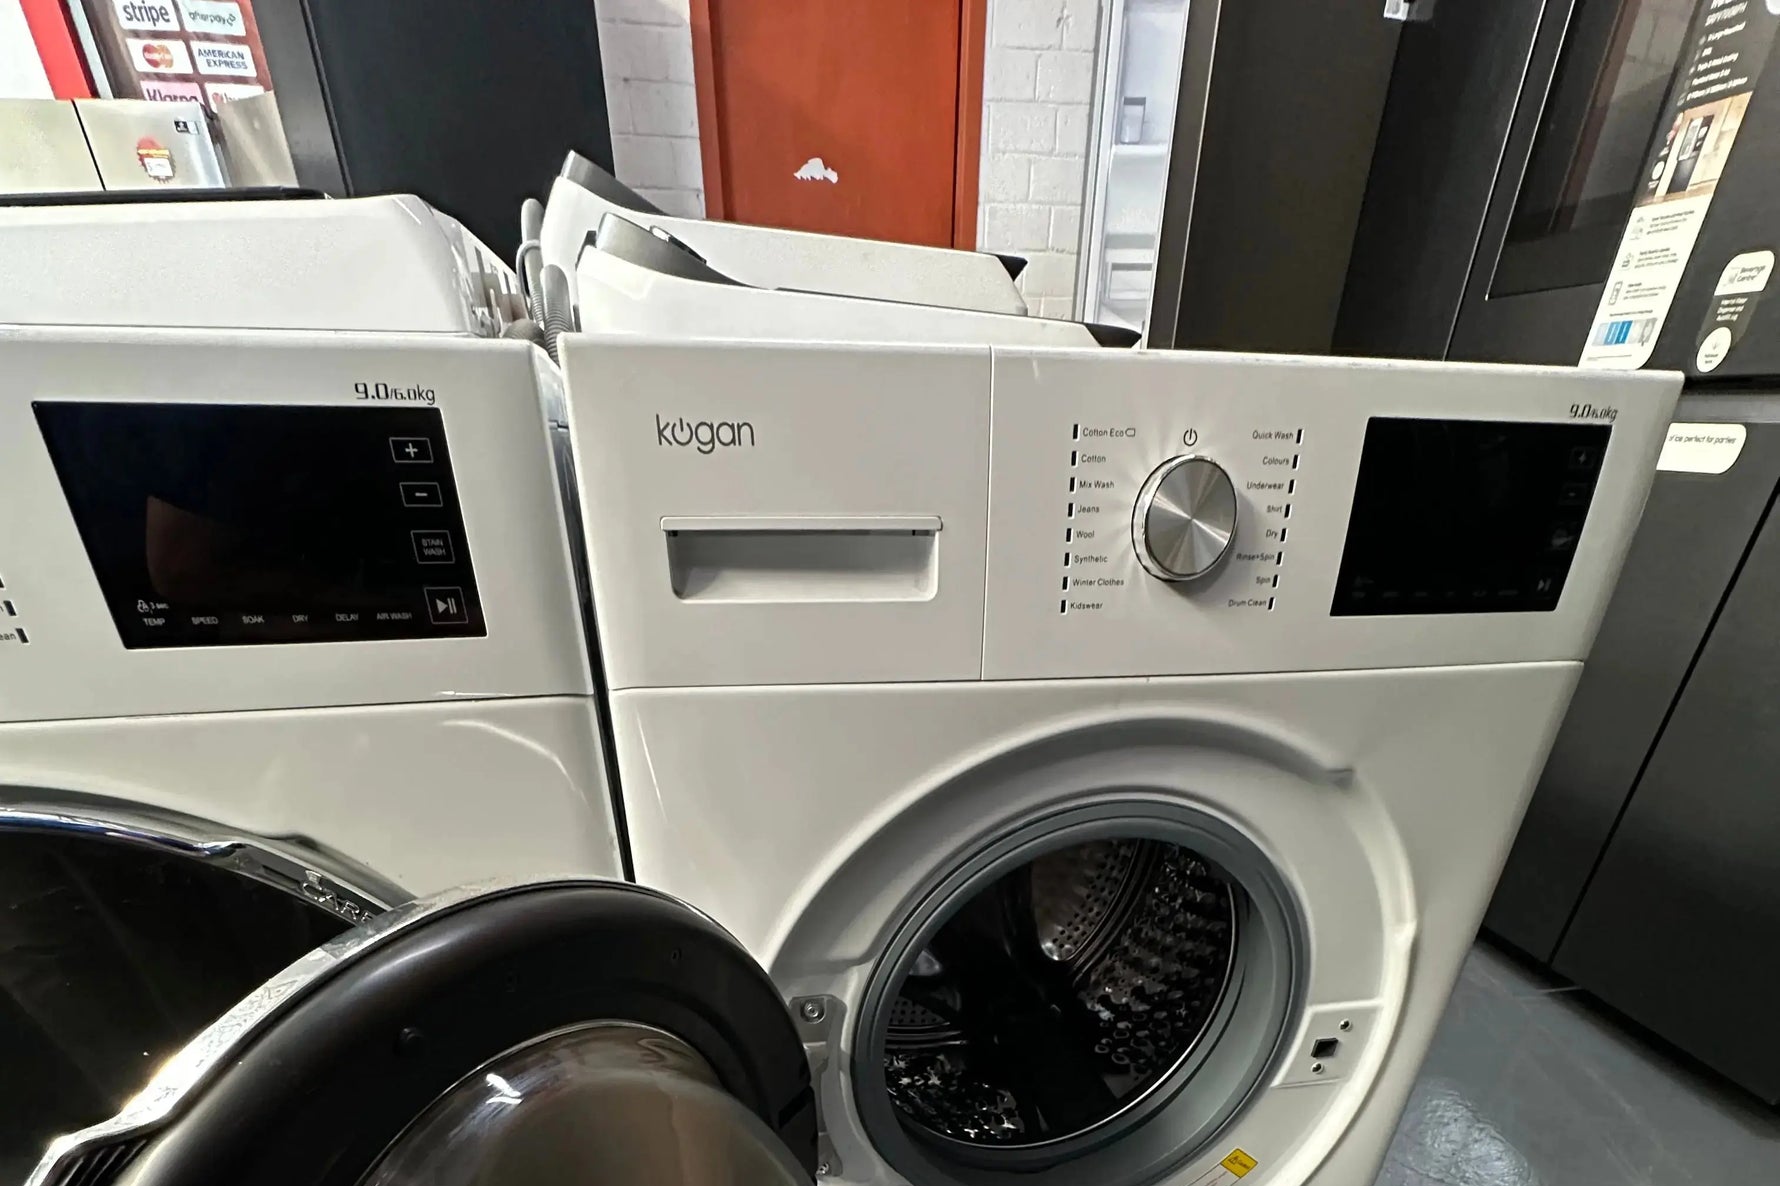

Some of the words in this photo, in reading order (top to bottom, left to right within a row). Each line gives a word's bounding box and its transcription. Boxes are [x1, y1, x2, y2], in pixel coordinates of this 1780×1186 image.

[122, 1, 171, 27] stripe
[198, 48, 245, 60] AMERICAN
[206, 59, 248, 70] EXPRESS
[656, 413, 755, 455] kogan
[1082, 428, 1108, 437] Cotton
[1109, 428, 1124, 437] Eco
[1252, 431, 1273, 440] Quick
[1274, 431, 1294, 440] Wash
[1081, 454, 1106, 463] Cotton
[1262, 456, 1290, 466] Colours
[1079, 480, 1092, 489] Mix
[1093, 480, 1115, 489] Wash
[1246, 481, 1284, 490] Underwear
[1077, 505, 1100, 514] Jeans
[1076, 529, 1095, 539] Wool
[1266, 529, 1278, 539] Dry
[1074, 554, 1108, 564] Synthetic
[1072, 578, 1096, 587] Winter
[1097, 578, 1124, 587] Clothes
[1256, 576, 1271, 586] Spin
[1070, 601, 1103, 610] Kidswear
[1228, 599, 1246, 607] Drum
[1247, 599, 1267, 607] Clean
[143, 617, 166, 627] TEMP
